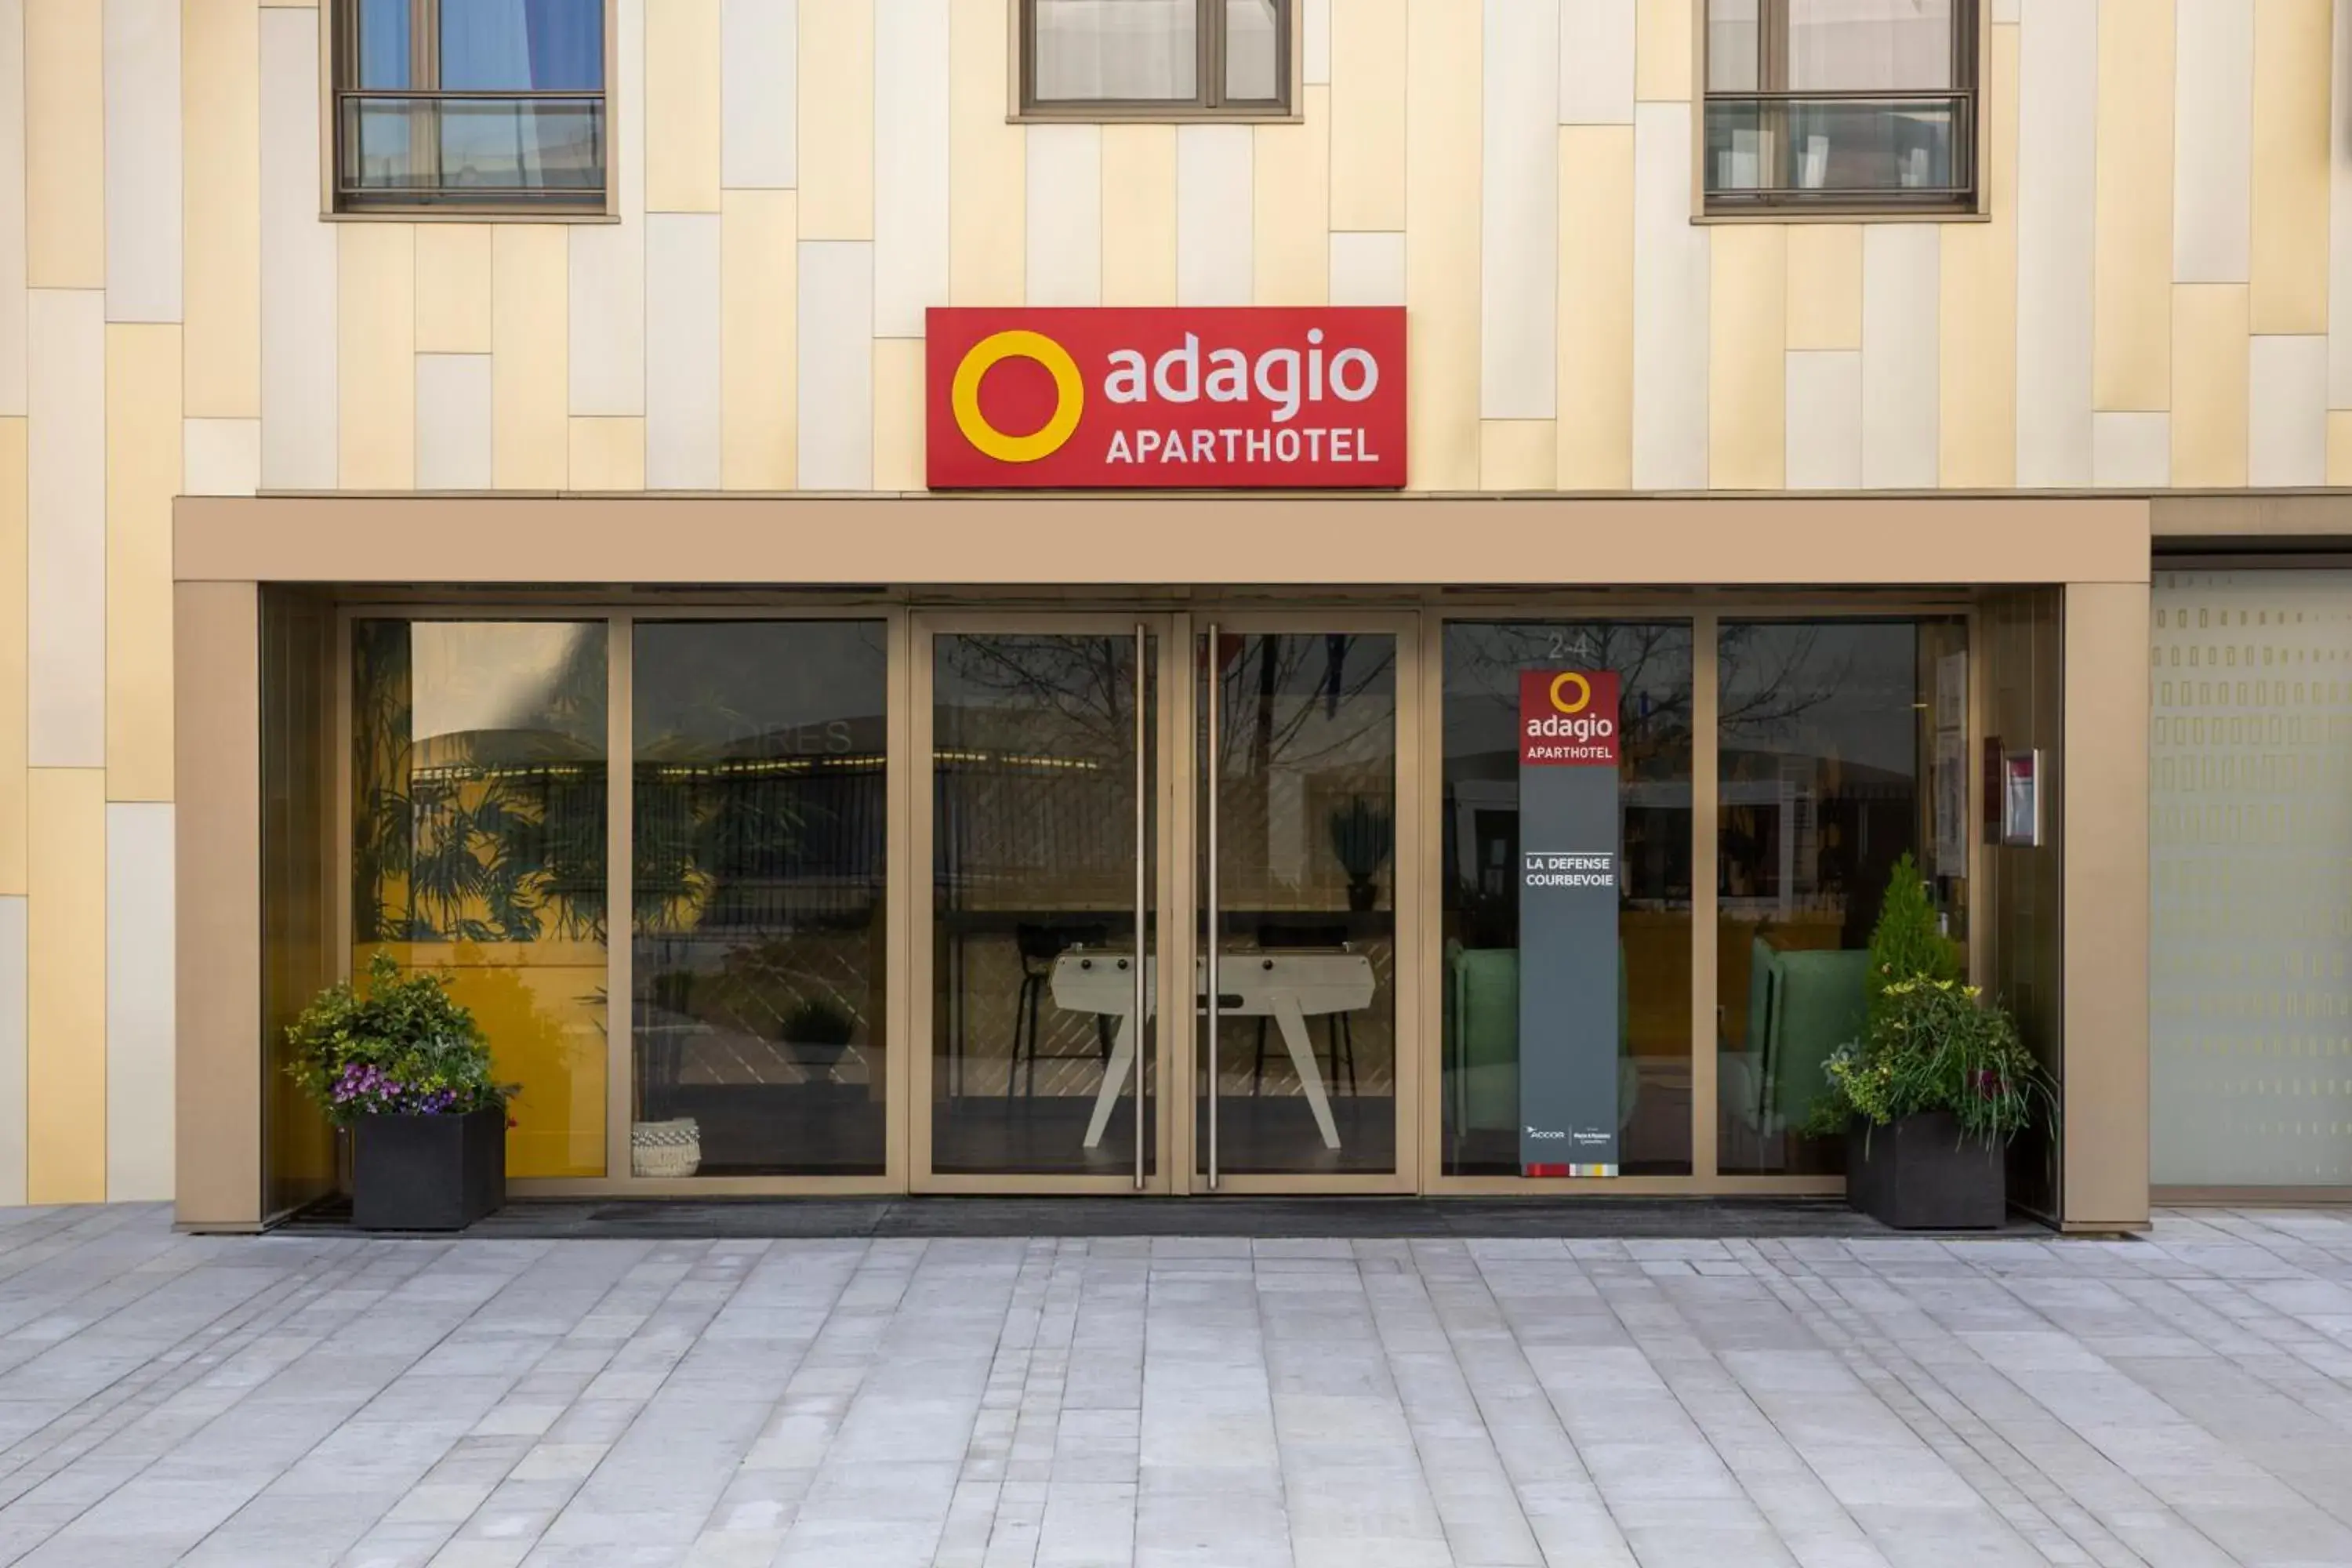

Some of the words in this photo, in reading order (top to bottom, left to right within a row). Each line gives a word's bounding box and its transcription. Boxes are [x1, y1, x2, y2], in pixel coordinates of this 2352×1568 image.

[1104, 328, 1379, 423] adagio
[1105, 428, 1379, 463] APARTHOTEL
[1527, 713, 1613, 743] adagio
[1528, 746, 1613, 758] APARTHOTEL
[1526, 858, 1544, 869] LA
[1548, 858, 1610, 869] DEFENSE
[1526, 874, 1613, 886] COURBEVOIE
